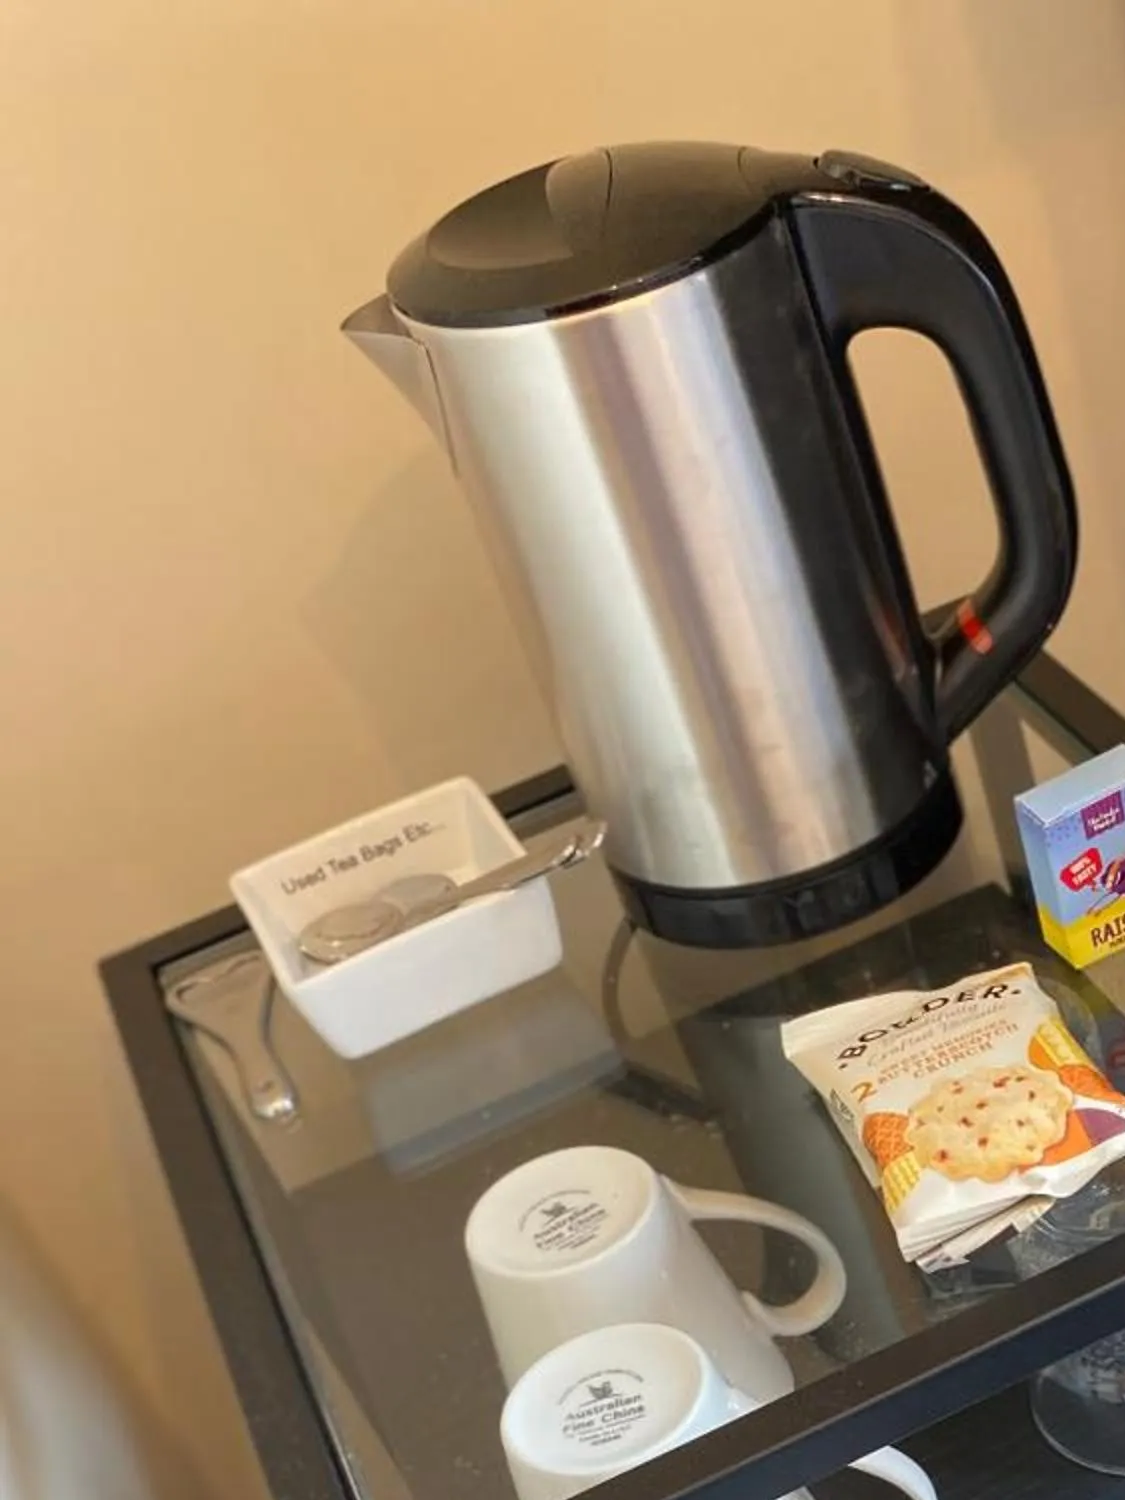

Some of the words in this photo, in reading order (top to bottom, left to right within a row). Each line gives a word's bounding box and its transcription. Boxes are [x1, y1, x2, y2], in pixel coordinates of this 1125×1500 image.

[281, 866, 326, 895] Used
[326, 855, 359, 874] Tea
[359, 837, 402, 862] Bags
[850, 1081, 878, 1105] 2
[878, 1023, 1019, 1085] BUTTERSCOTCH
[913, 1041, 994, 1079] CRUNCH
[562, 1420, 595, 1434] Fine
[601, 1405, 645, 1423] China
[565, 1394, 642, 1419] Australian
